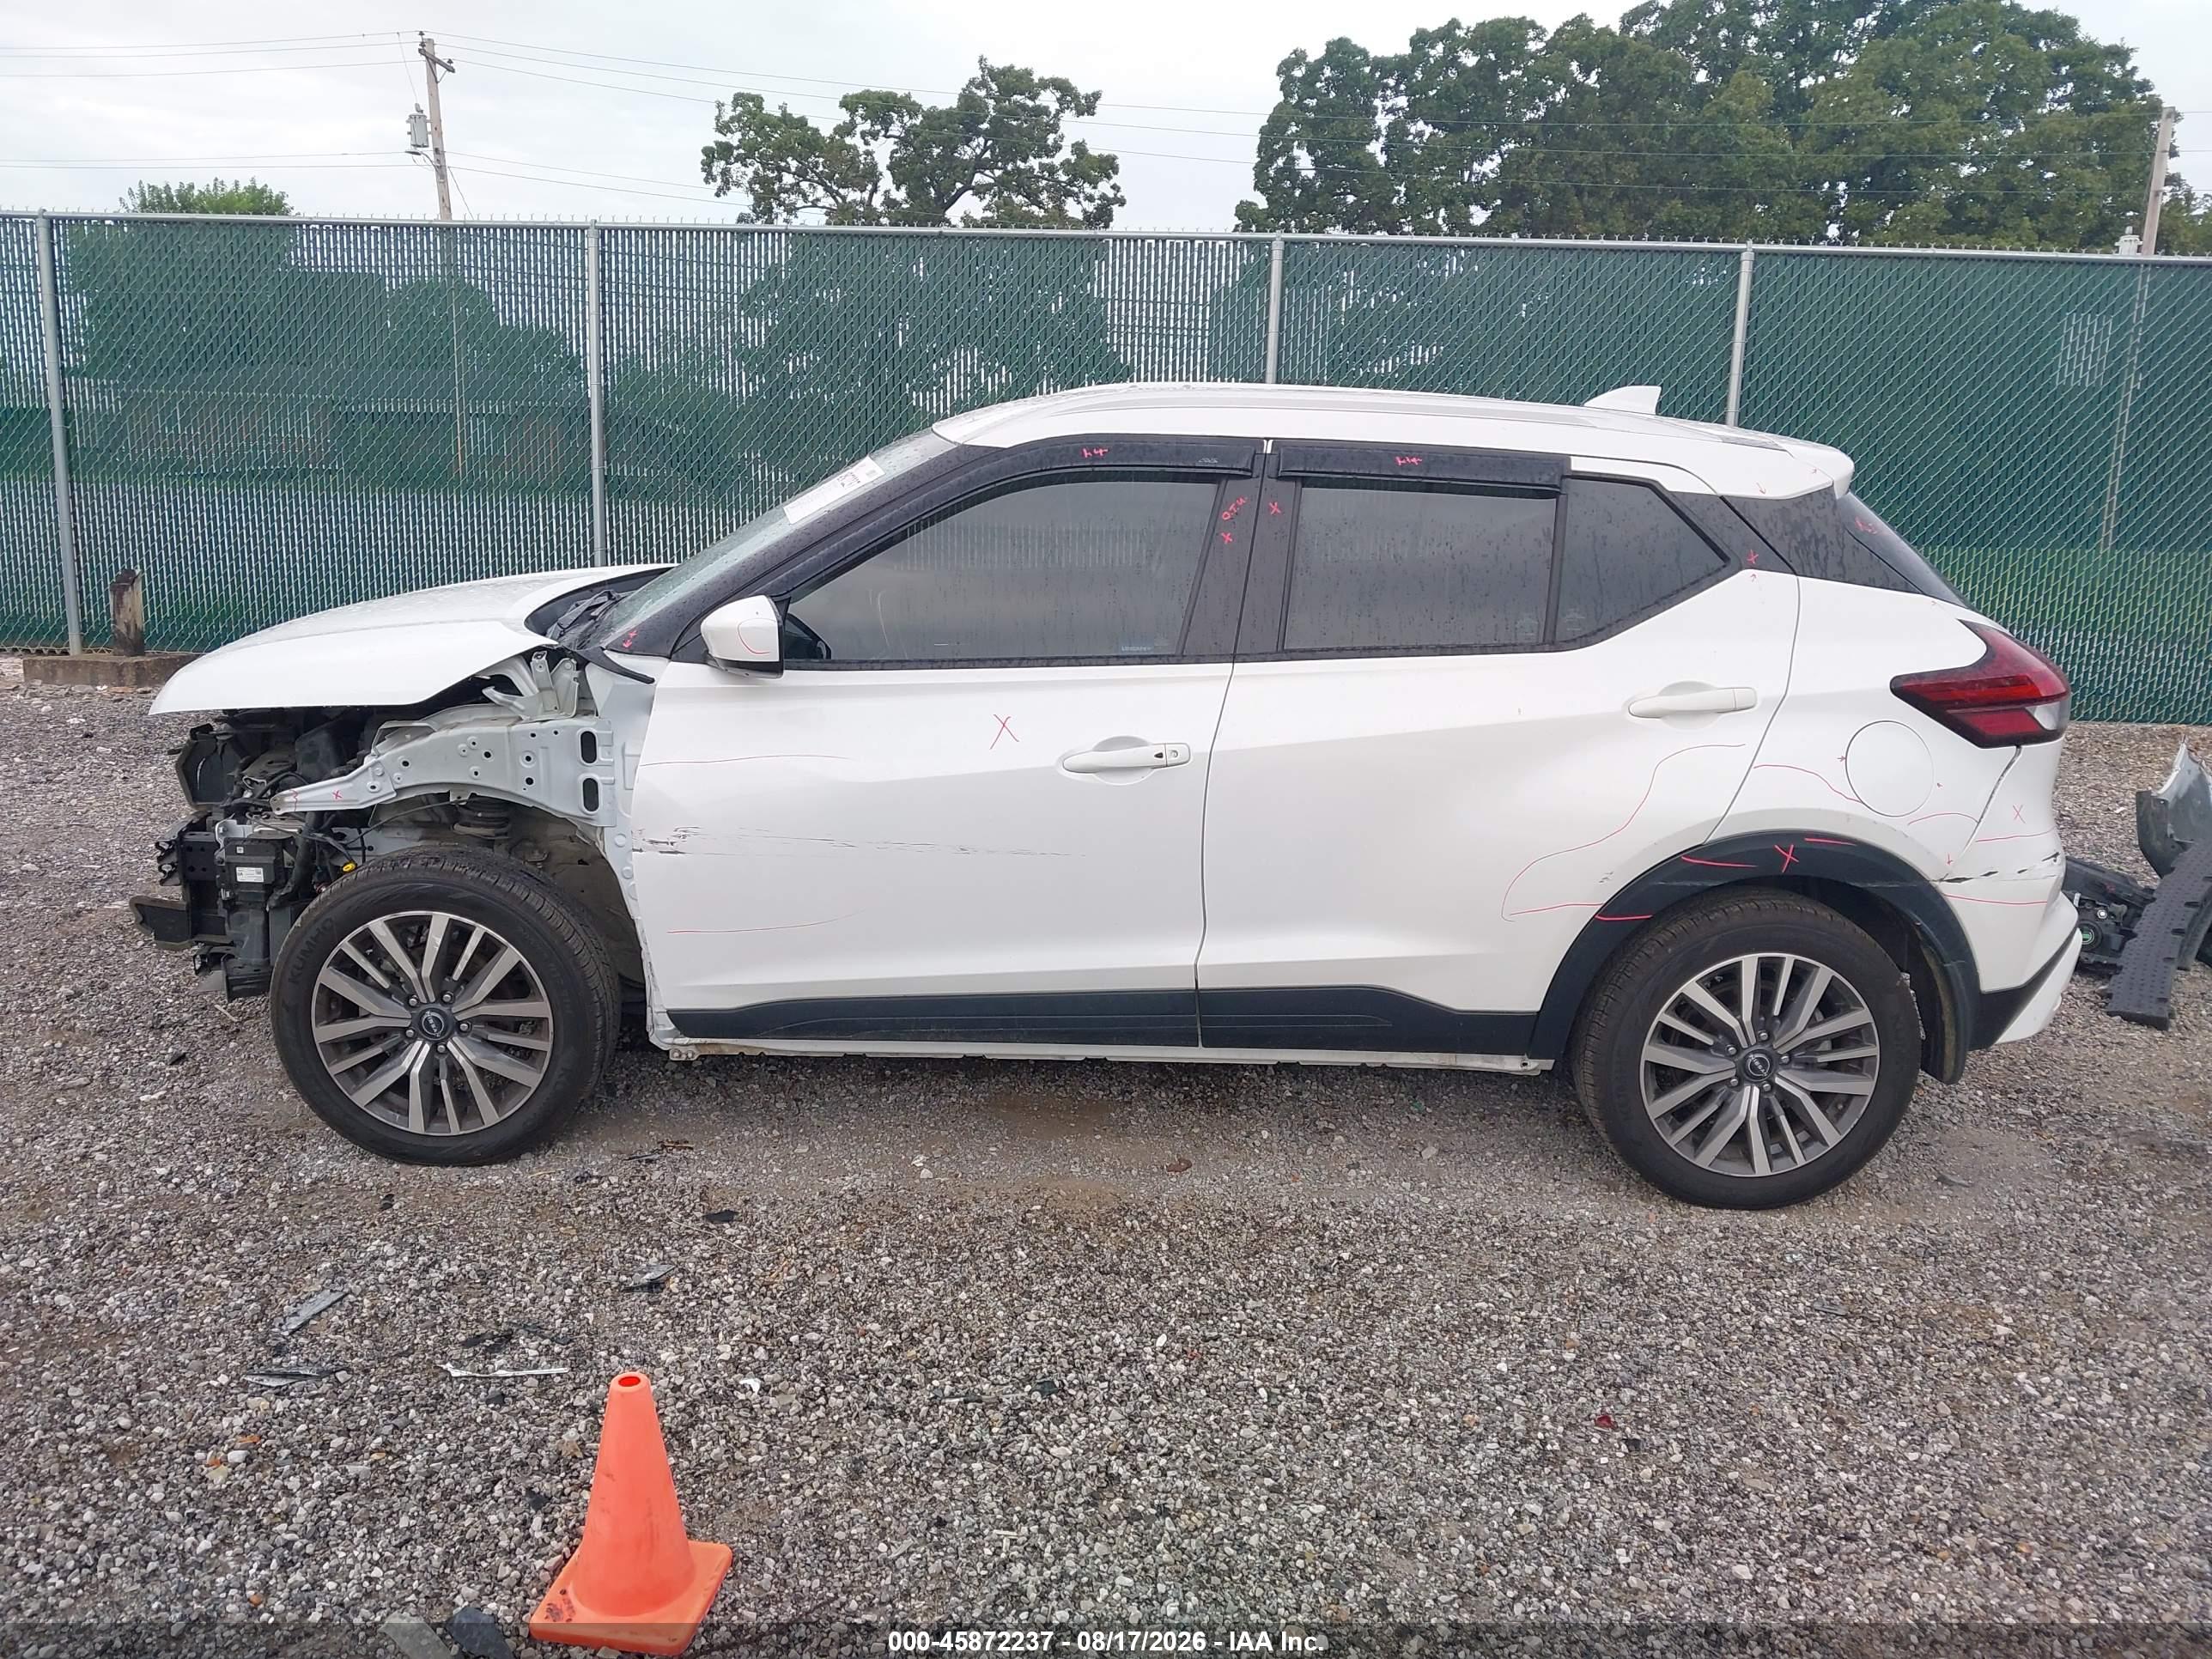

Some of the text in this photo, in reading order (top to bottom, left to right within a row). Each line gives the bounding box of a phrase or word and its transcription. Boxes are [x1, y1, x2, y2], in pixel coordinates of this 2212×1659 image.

[289, 916, 336, 984] KUMHO
[424, 1010, 441, 1038] NISSAN
[1748, 1054, 1769, 1077] NISSAN
